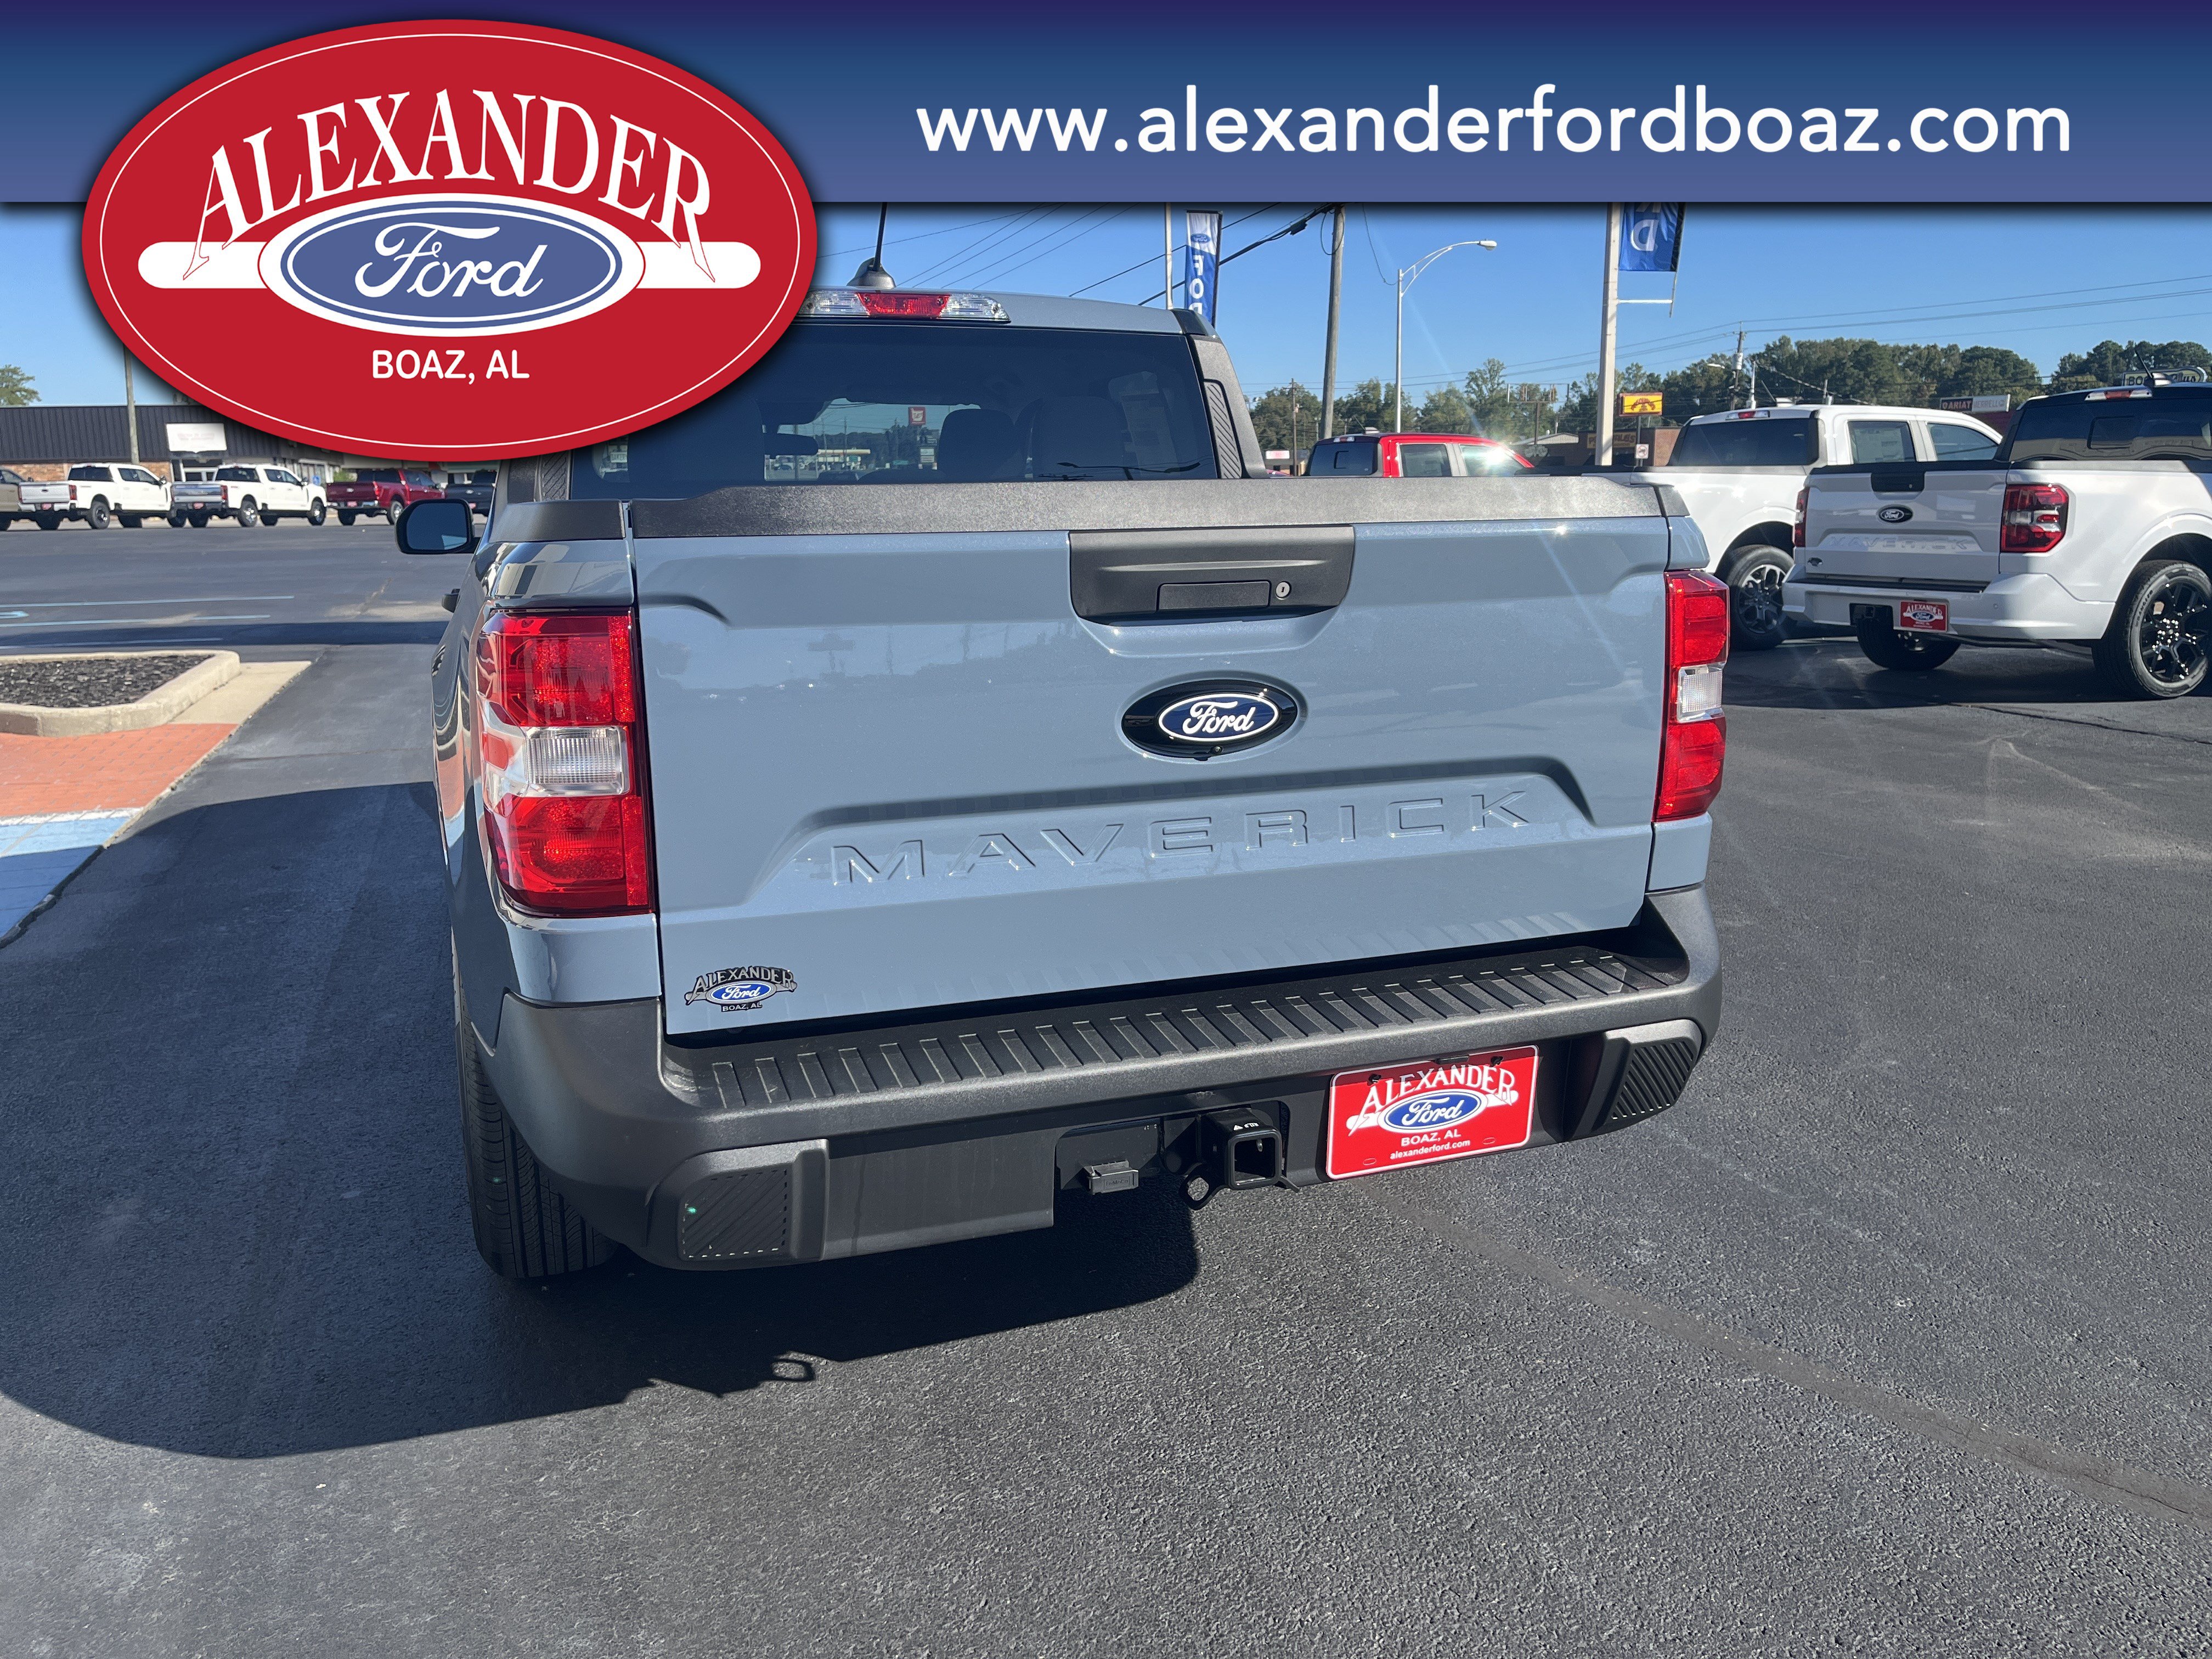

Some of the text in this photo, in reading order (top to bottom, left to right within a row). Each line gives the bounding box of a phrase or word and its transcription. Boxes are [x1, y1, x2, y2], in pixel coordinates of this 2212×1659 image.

[1948, 400, 1972, 410] ARIAT
[1830, 535, 1968, 550] MAVERICK
[1182, 700, 1257, 735] Ford
[830, 789, 1532, 888] MAVERICK
[686, 966, 795, 1005] ALEXANDER
[721, 983, 761, 1000] Ford
[721, 1003, 749, 1012] BOAZ,
[1347, 1064, 1516, 1137] ALEXANDER
[1401, 1096, 1463, 1126] Ford
[1401, 1127, 1462, 1147] BOAZ, AL
[1389, 1138, 1471, 1160] alexanderford.com
